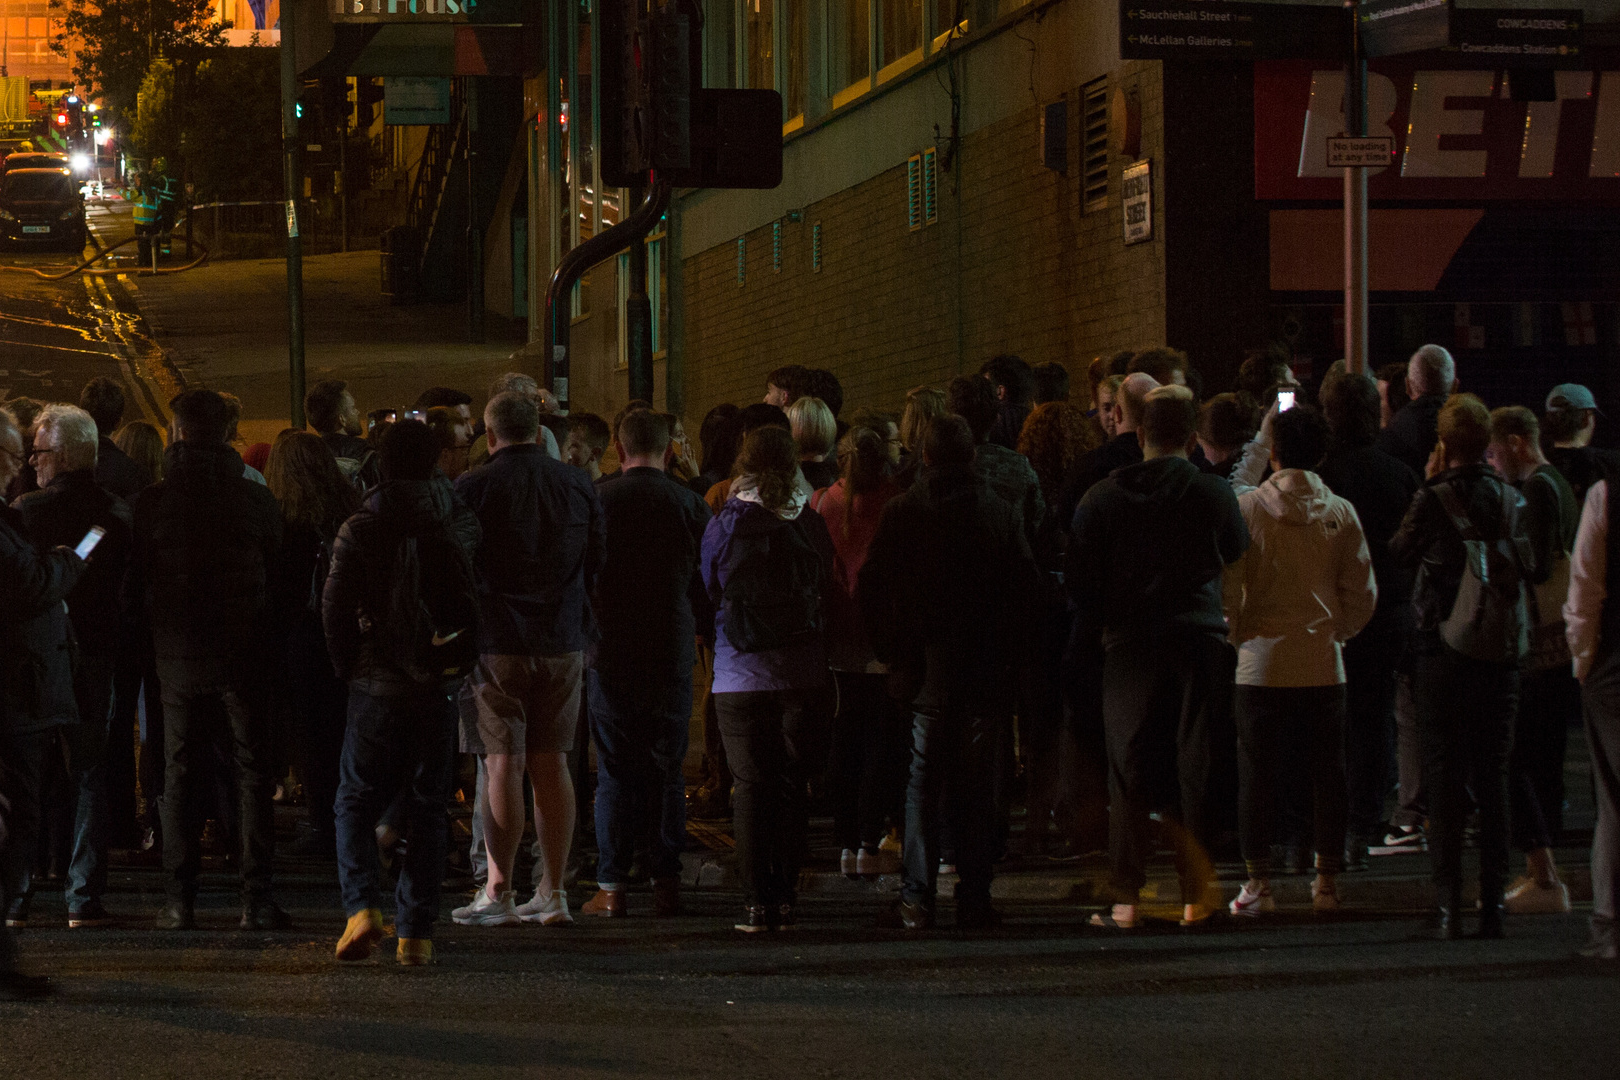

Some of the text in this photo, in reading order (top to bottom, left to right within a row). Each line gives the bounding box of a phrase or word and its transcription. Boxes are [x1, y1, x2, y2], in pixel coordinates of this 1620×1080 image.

[1139, 9, 1198, 20] Sauchiehall
[1200, 10, 1231, 22] Street
[1497, 18, 1567, 30] COWCADDENS
[1139, 35, 1185, 46] McLellan
[1187, 36, 1232, 47] Galleries
[1461, 42, 1522, 54] Cowcaddens
[1523, 43, 1558, 55] Station
[1333, 142, 1386, 152] No loading
